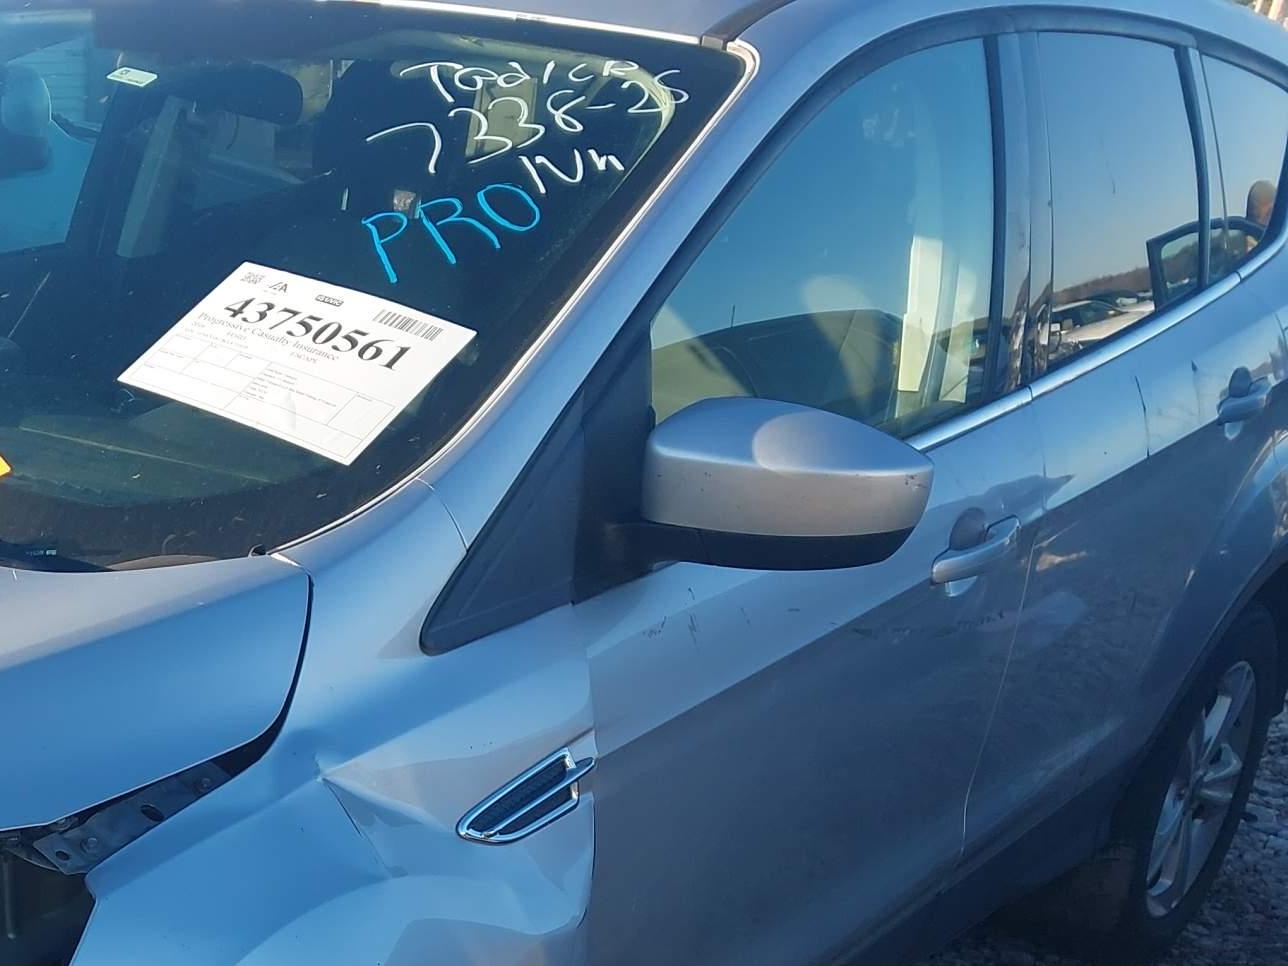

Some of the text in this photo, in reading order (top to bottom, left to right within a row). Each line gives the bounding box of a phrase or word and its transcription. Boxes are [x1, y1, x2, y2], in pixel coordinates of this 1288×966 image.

[361, 182, 541, 284] PRO
[223, 297, 412, 371] 43750561
[292, 341, 339, 361] Insurance
